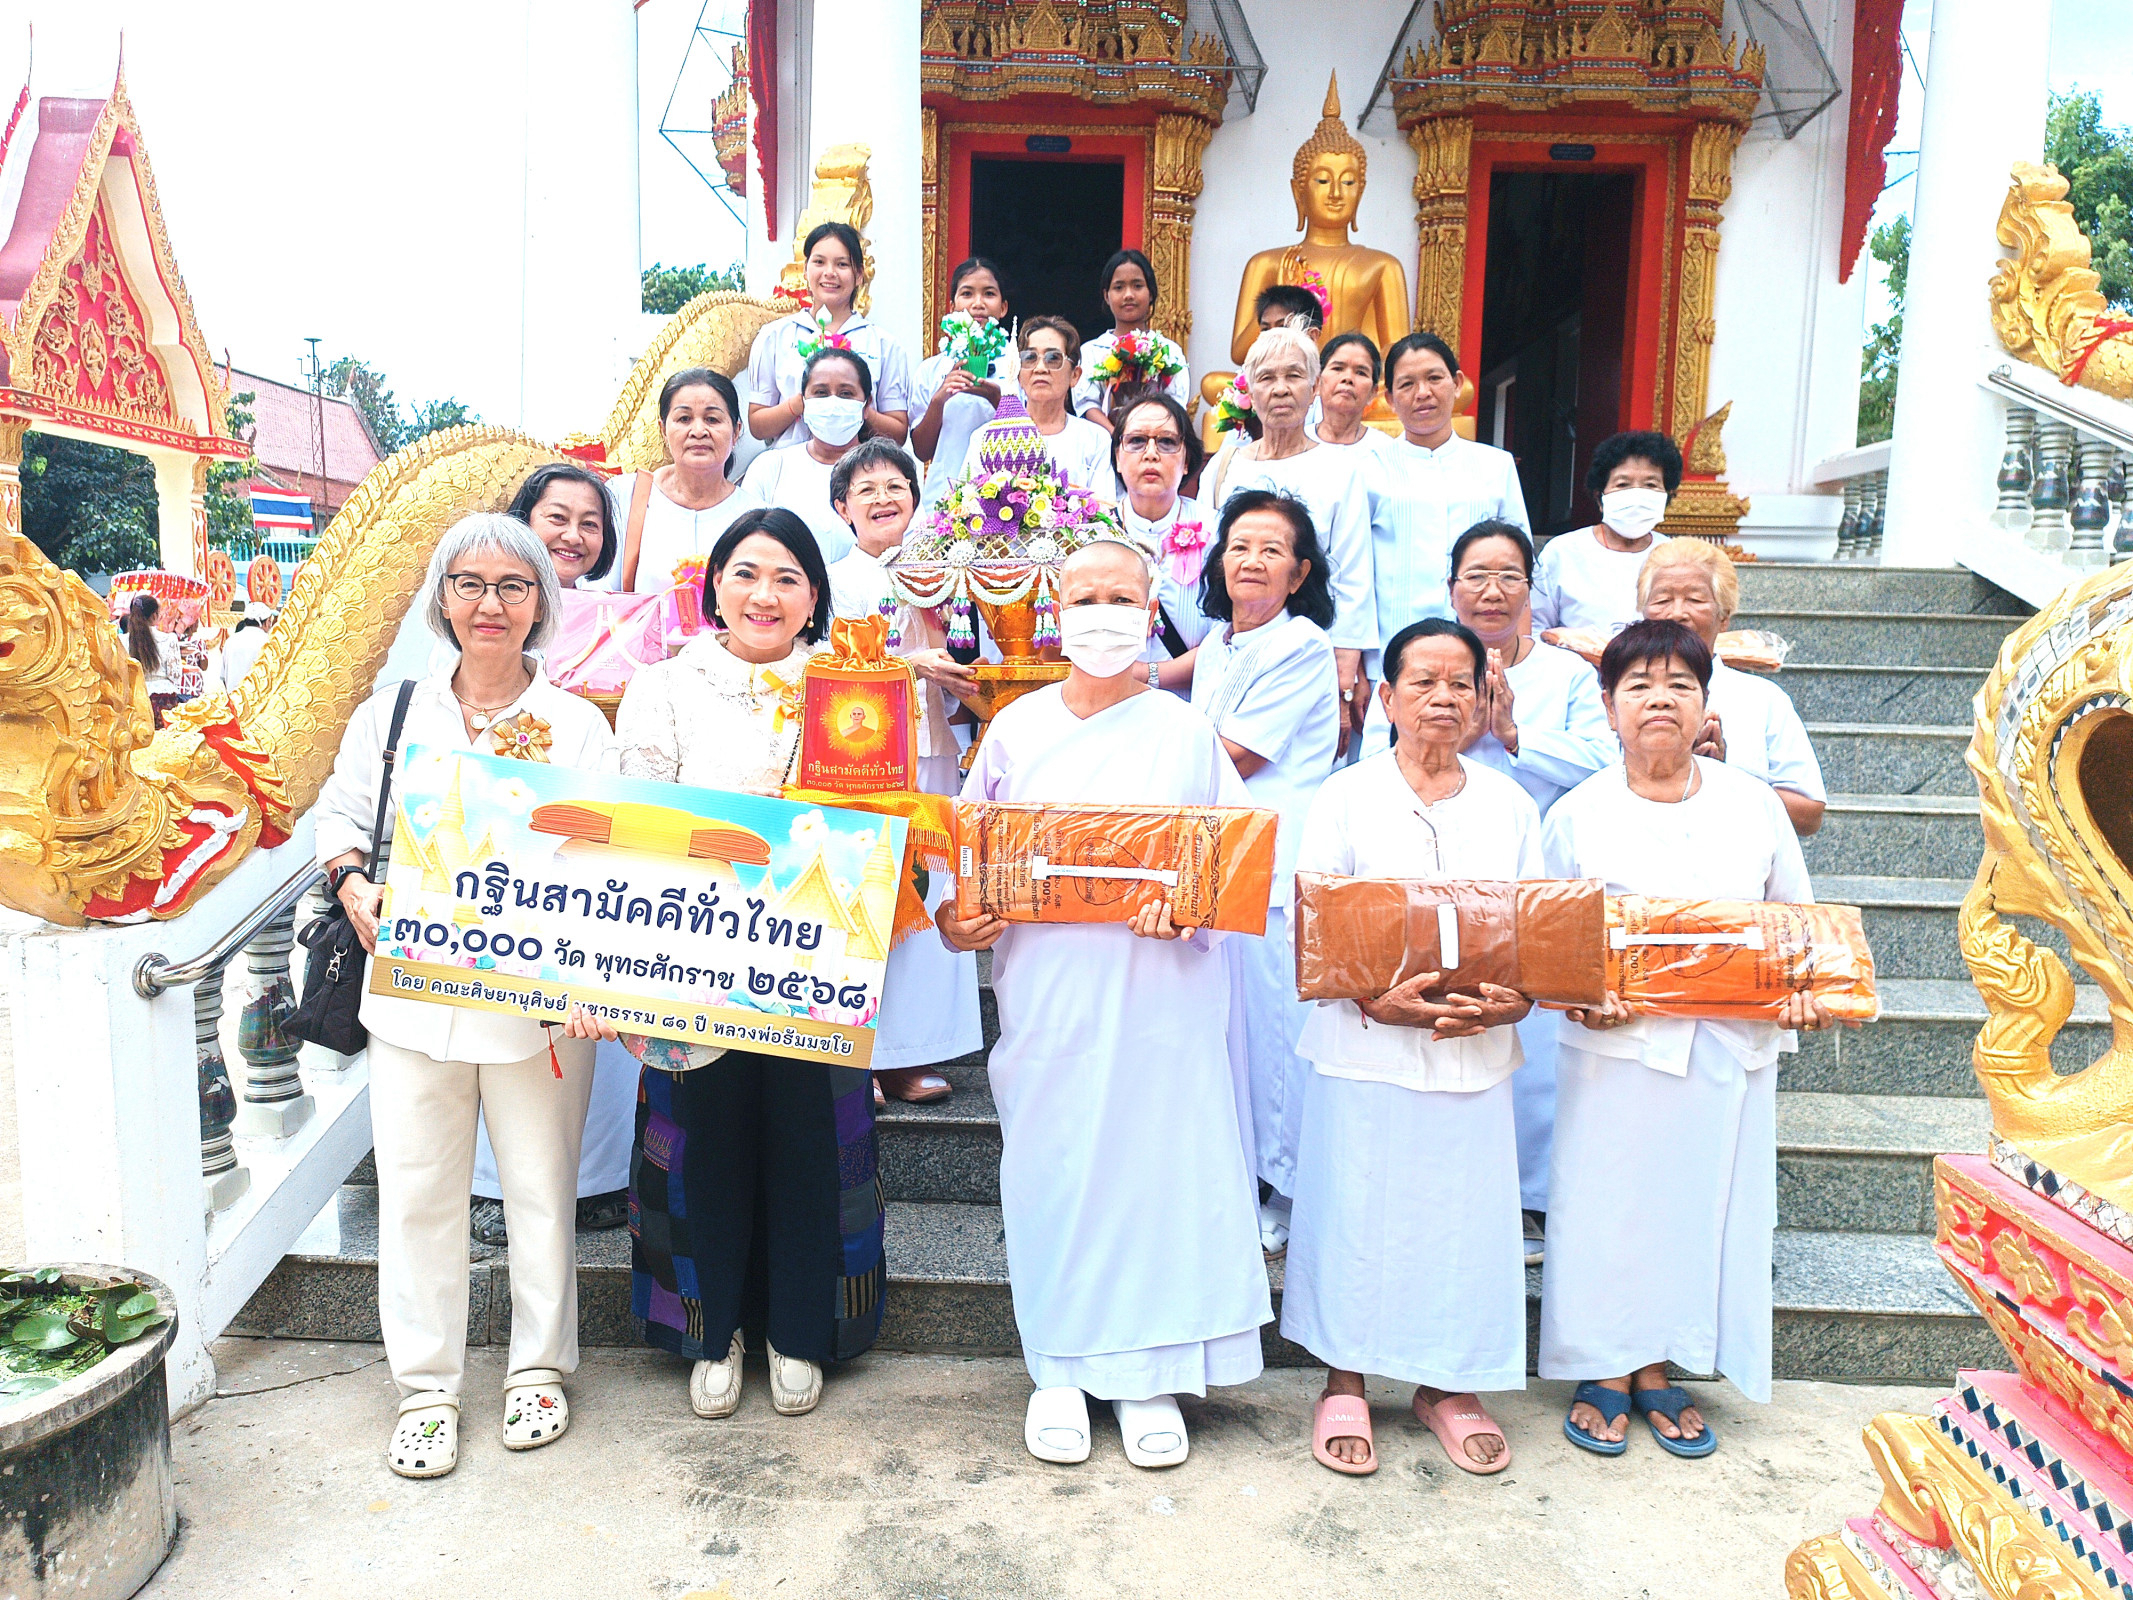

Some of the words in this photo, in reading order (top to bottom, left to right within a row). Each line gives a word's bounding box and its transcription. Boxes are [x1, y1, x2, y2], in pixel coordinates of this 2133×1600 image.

[808, 760, 904, 776] กฐินสามัคคีทั่วไทย
[833, 780, 844, 788] วัด
[845, 781, 885, 791] พุทธศักราช
[455, 861, 823, 951] กฐินสามัคคีทั่วไทย
[394, 917, 543, 961] ๓๐,๐๐๐
[554, 937, 586, 968] วัด
[594, 951, 735, 990] พุทธศักราช
[747, 965, 868, 1010] ๒๕๖๘
[1630, 949, 1639, 979] 100%
[391, 968, 425, 990] โดย
[430, 977, 568, 1012] คณะศิษยานุศิษย์
[574, 1001, 656, 1025] ชาธรรม
[662, 1014, 688, 1031] ๘๑
[695, 1014, 708, 1033] ปี
